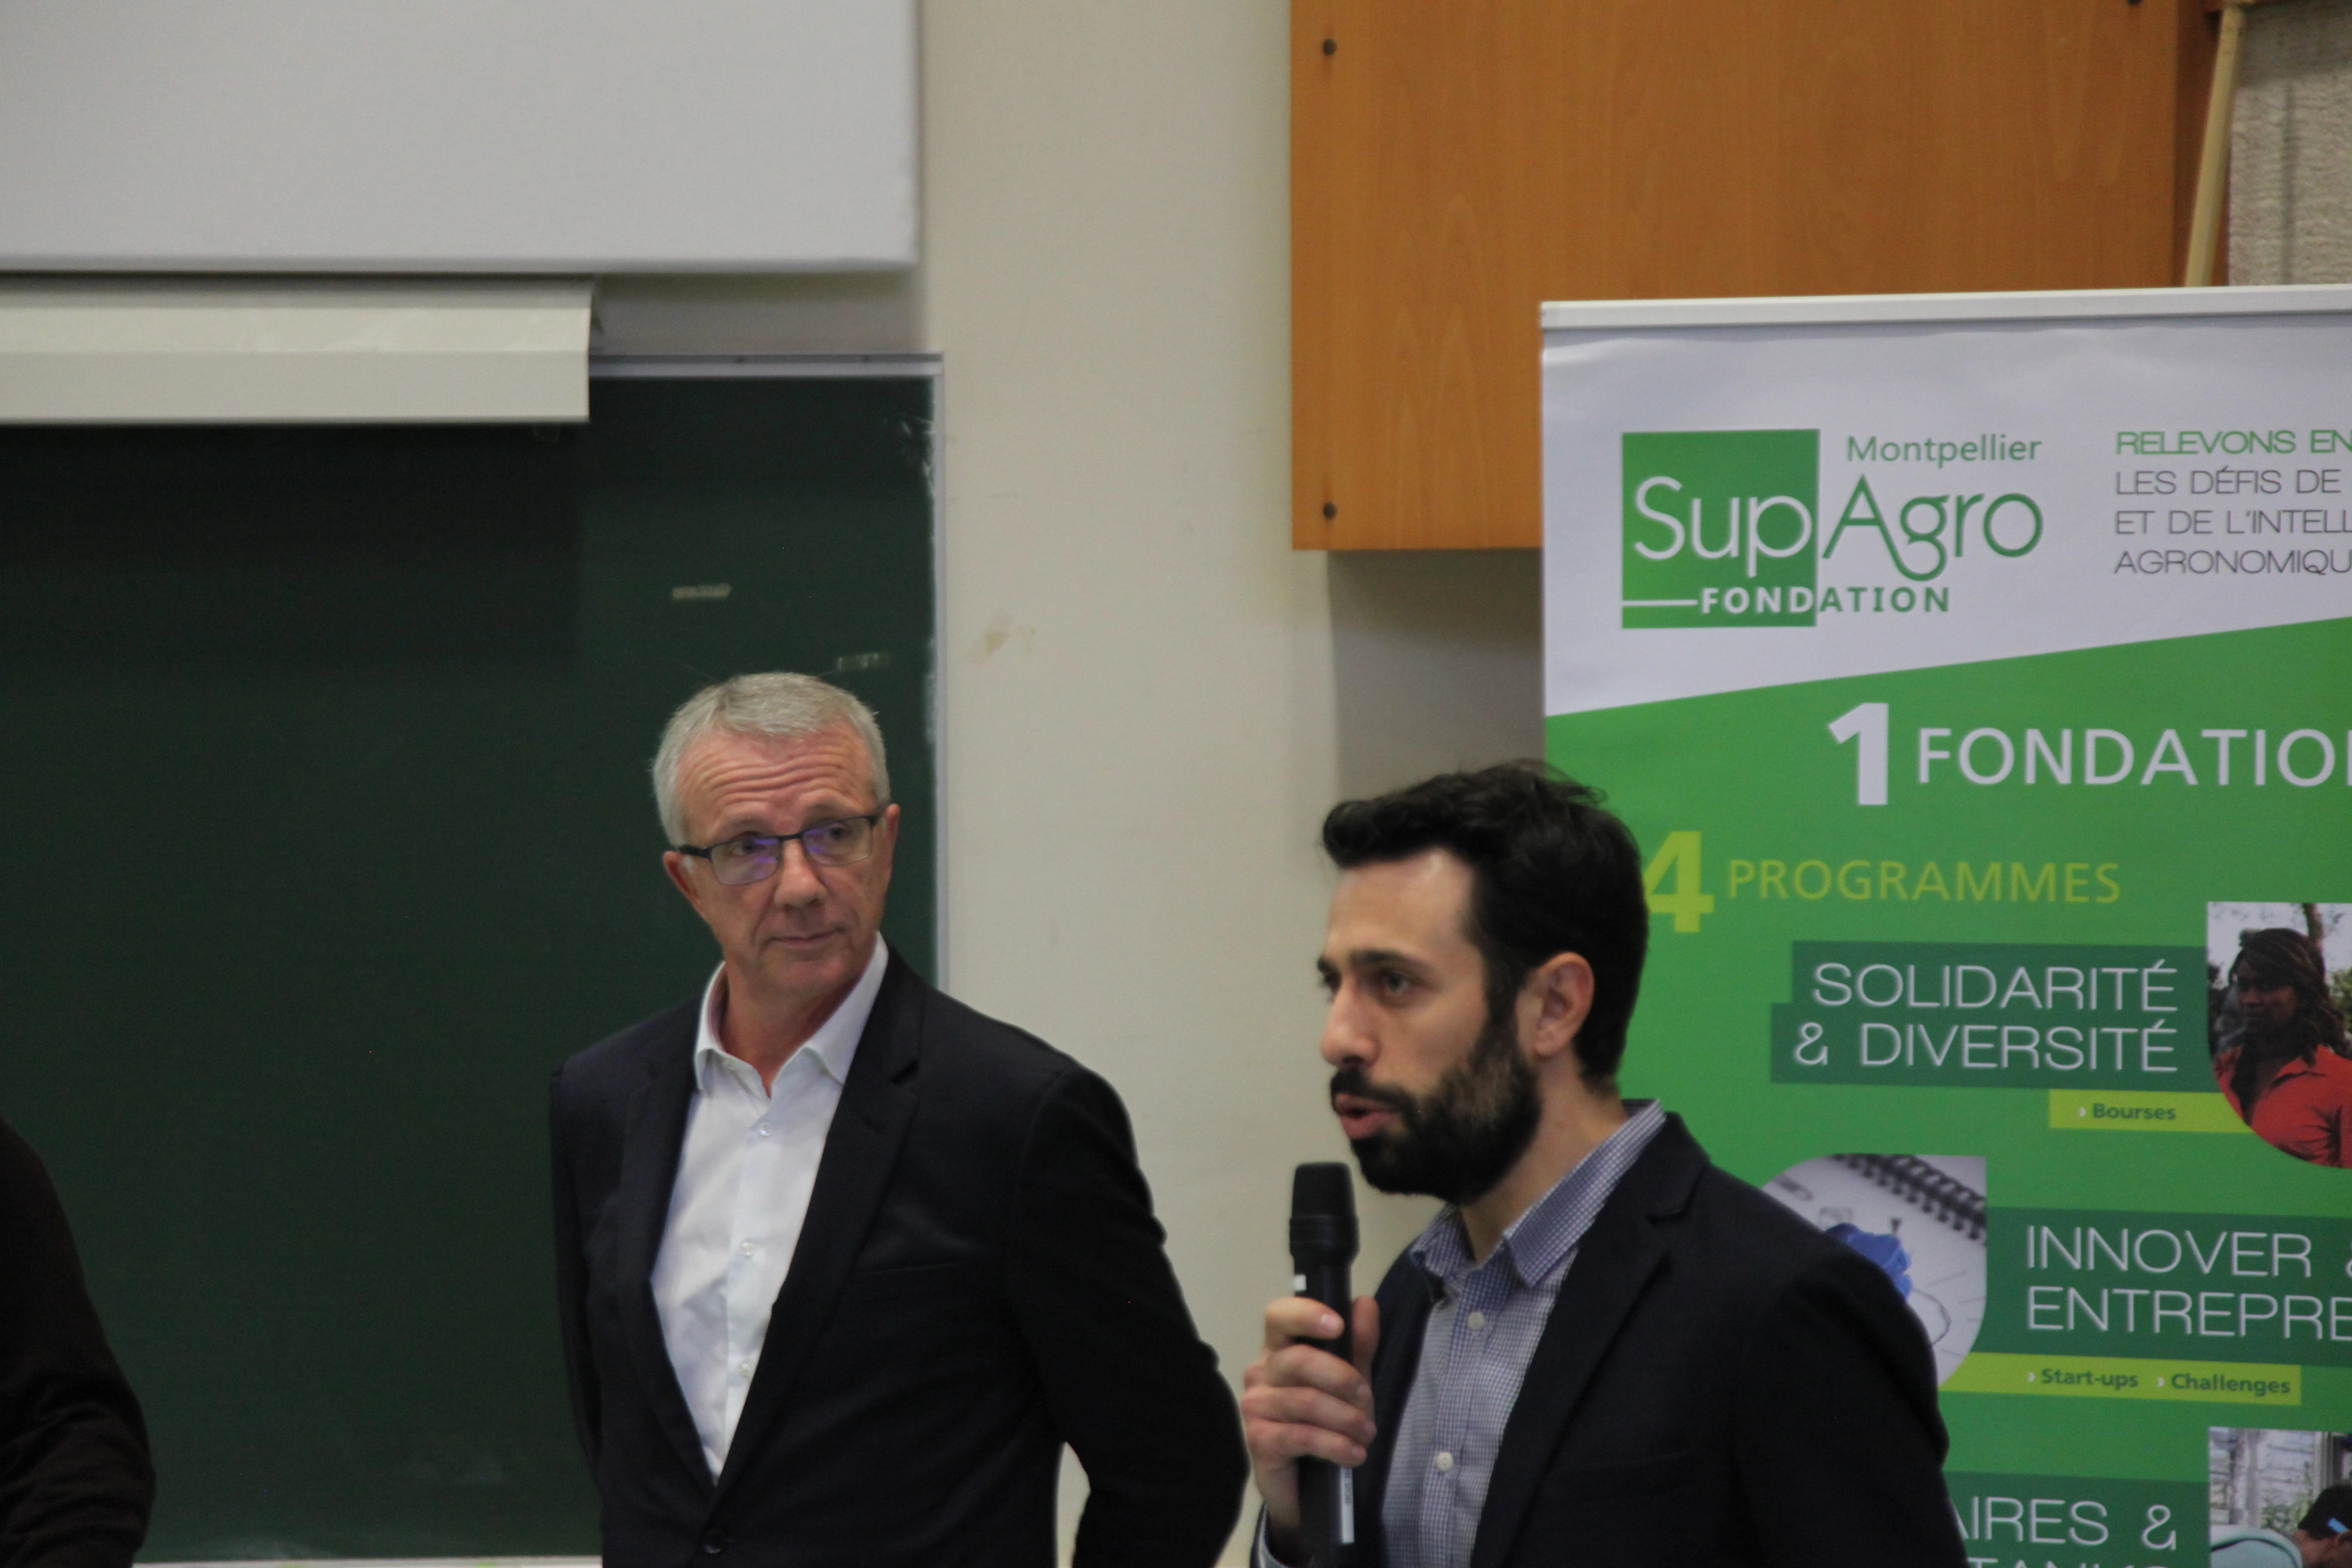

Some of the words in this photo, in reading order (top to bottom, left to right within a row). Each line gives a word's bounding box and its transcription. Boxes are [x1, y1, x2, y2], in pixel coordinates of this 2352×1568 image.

[1848, 434, 2041, 468] Montpellier
[2117, 430, 2296, 454] RELEVONS
[2116, 470, 2176, 495] LES
[2191, 466, 2281, 494] DÉFIS
[2296, 469, 2341, 494] DE
[2115, 511, 2155, 535] ET
[2169, 510, 2213, 534] DE
[2115, 549, 2352, 575] AGRONOMIQU
[1701, 586, 1949, 614] FONDATION
[1828, 703, 1888, 805] 1
[1919, 727, 2352, 787] FONDATIO
[1643, 831, 1714, 932] 4
[1728, 859, 2120, 903] PROGRAMMES
[1813, 959, 2177, 1011] SOLIDARITÉ
[1794, 1022, 1828, 1065] &
[1861, 1019, 2177, 1072] DIVERSITÉ
[2092, 1103, 2176, 1120] Bourses
[2028, 1226, 2311, 1277] INNOVER
[2042, 1368, 2138, 1390] Start-ups
[2171, 1373, 2290, 1397] Challenges
[1954, 1496, 2108, 1545] IRES
[2142, 1505, 2176, 1550] &
